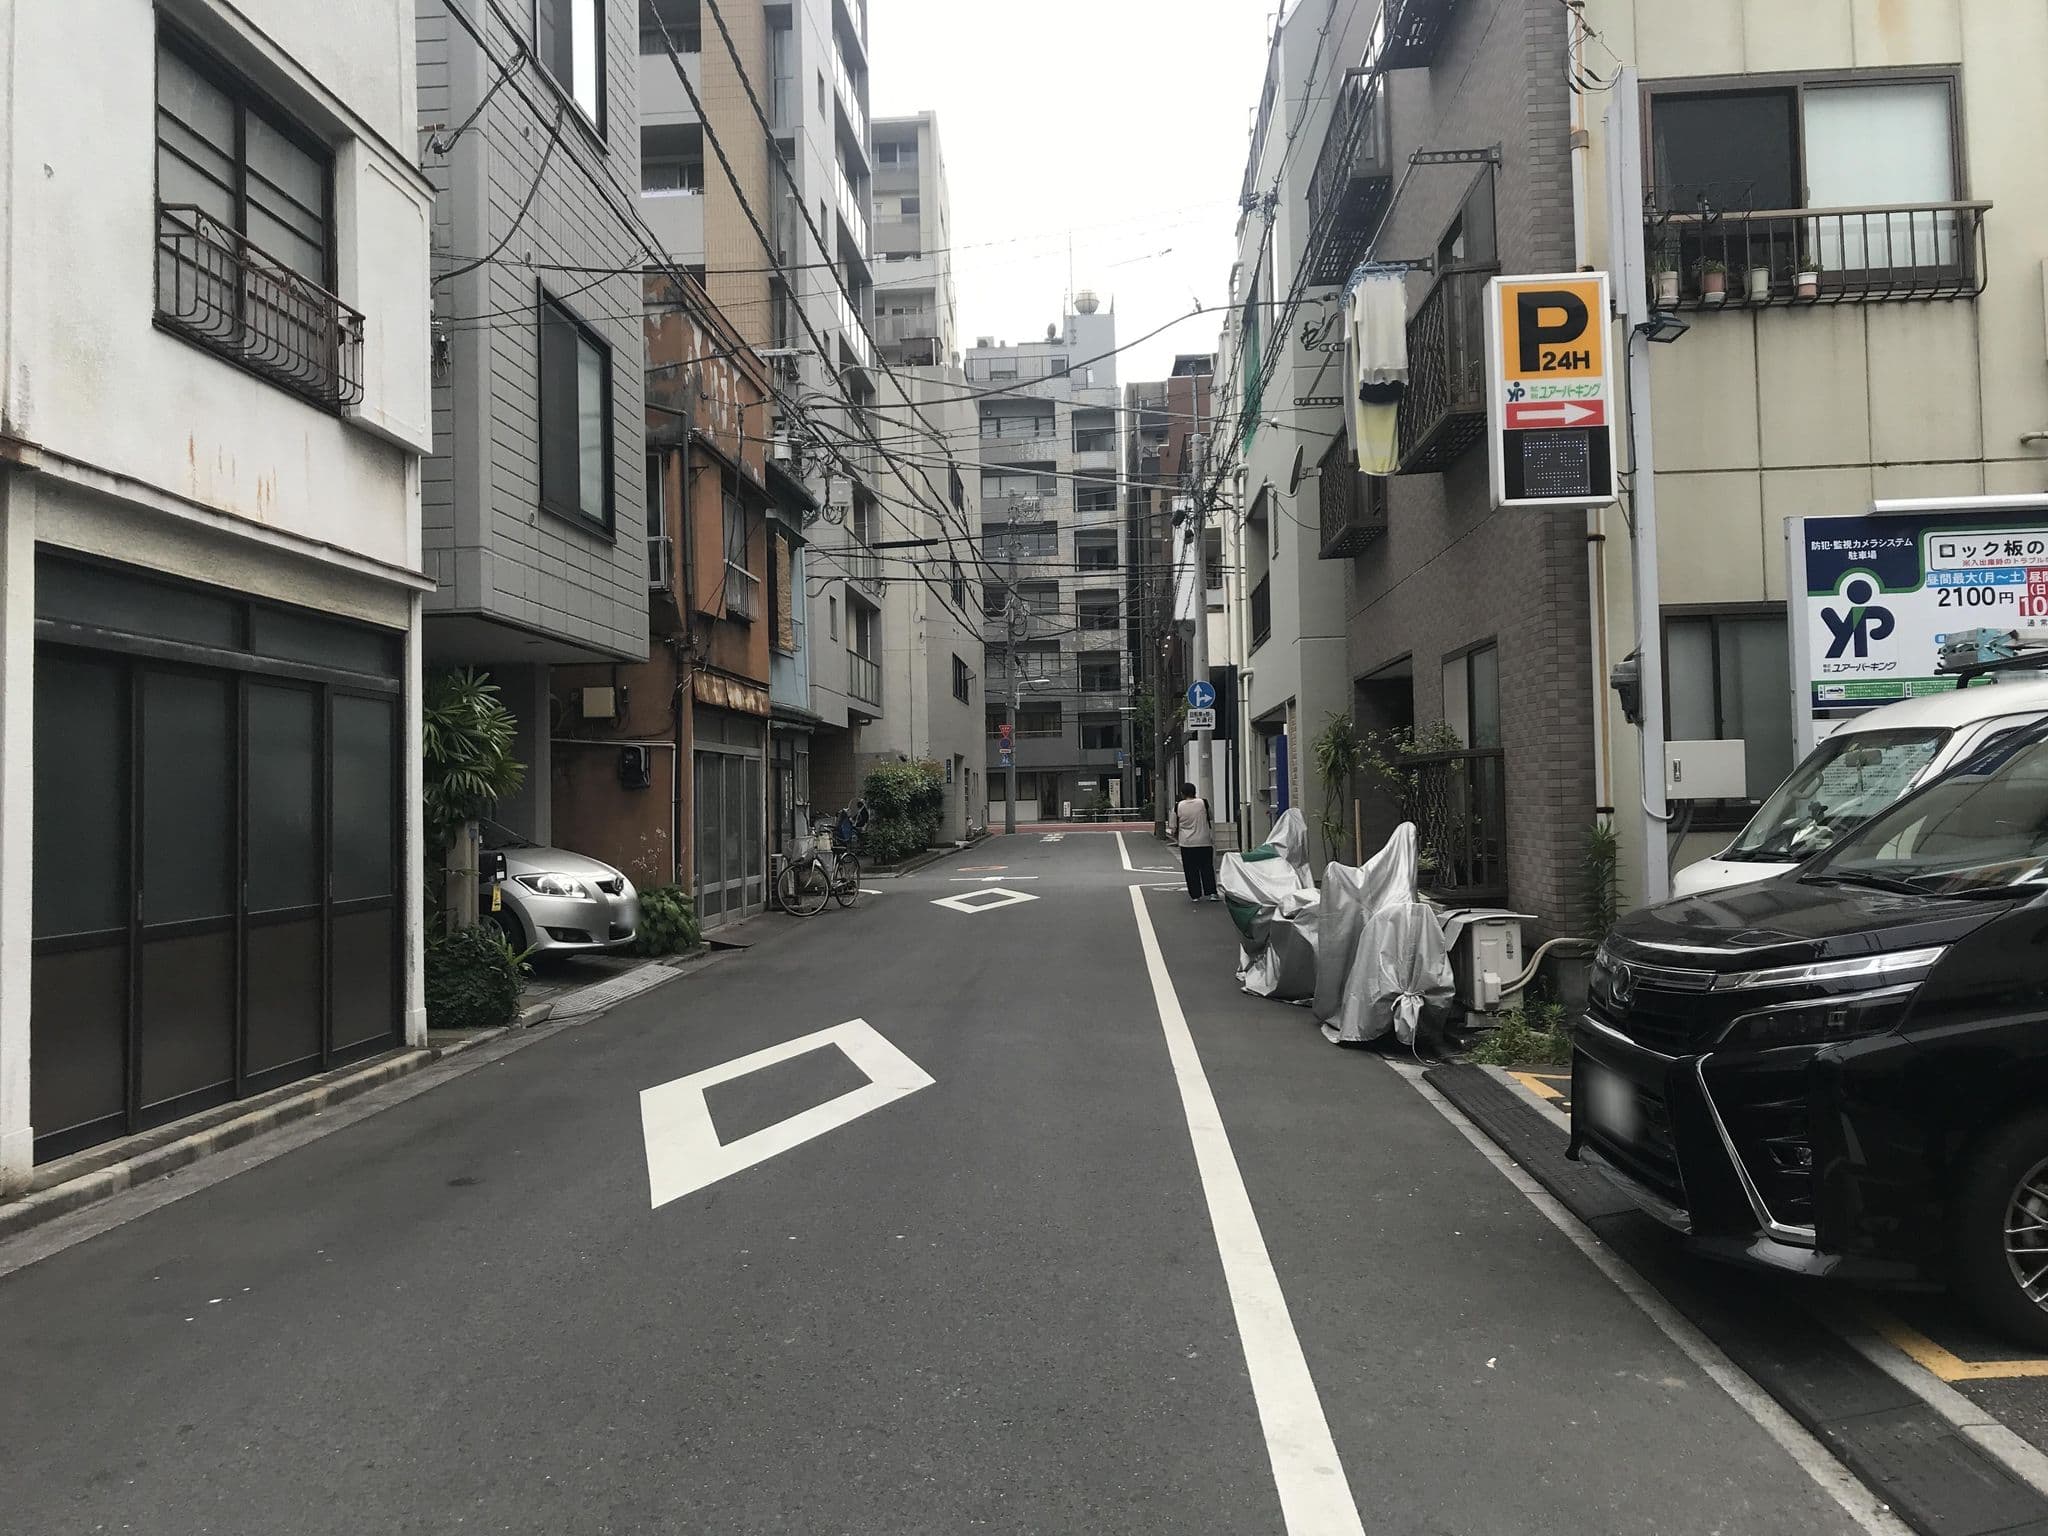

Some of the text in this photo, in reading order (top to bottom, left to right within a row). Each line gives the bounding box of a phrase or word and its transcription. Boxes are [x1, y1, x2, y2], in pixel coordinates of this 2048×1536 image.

[1517, 291, 1588, 372] P
[1542, 350, 1590, 371] 24H
[1848, 550, 1877, 560] 駐車場
[1939, 539, 2045, 559] ロック板の
[1937, 587, 2014, 608] 2100円
[1832, 661, 1897, 673] ユアーパーキング
